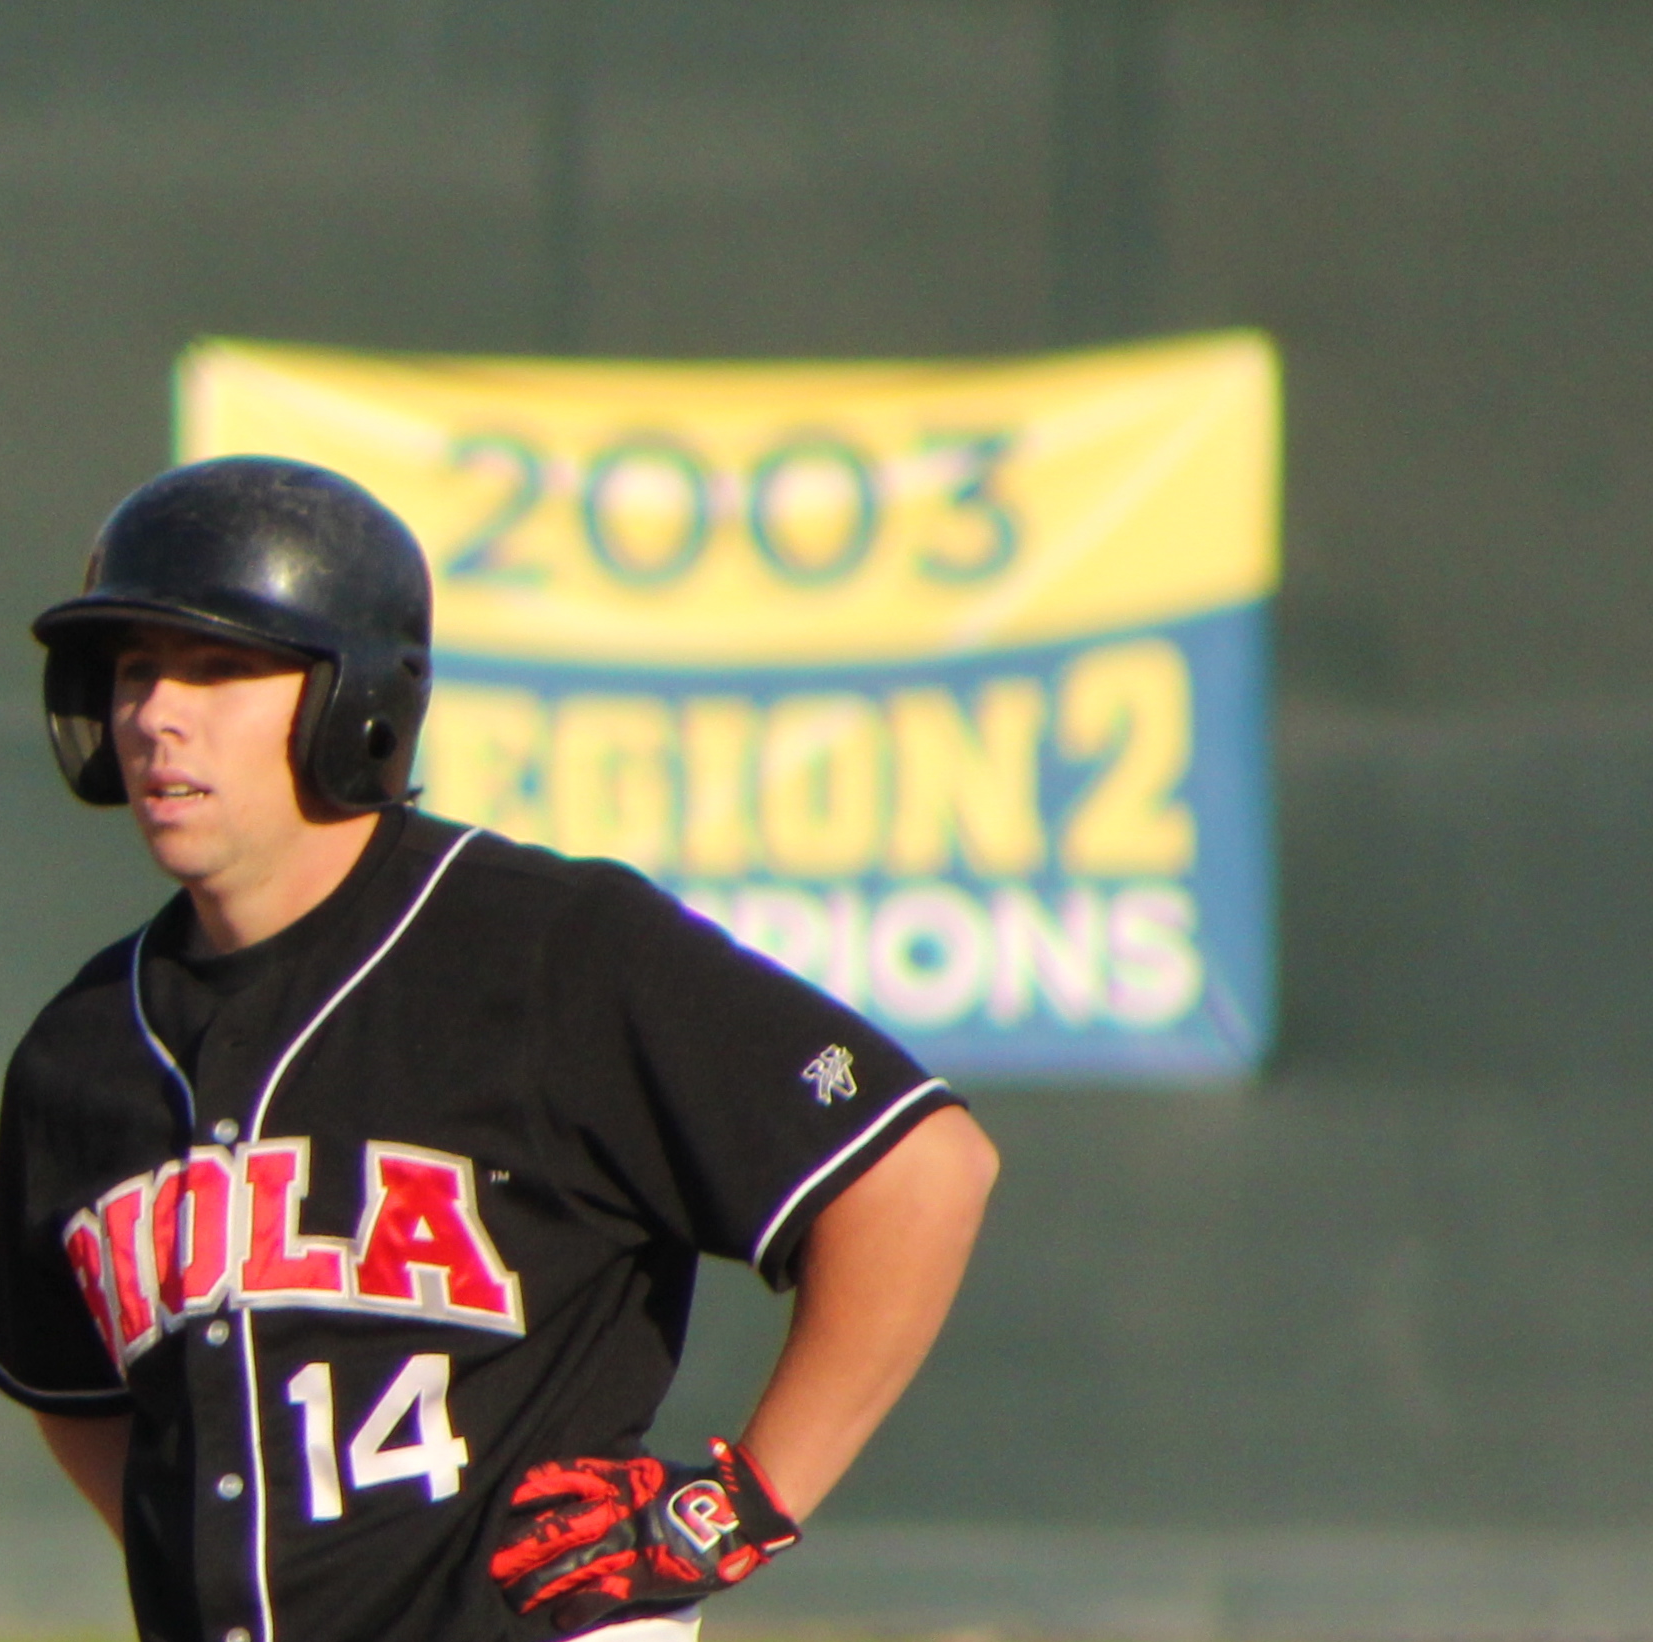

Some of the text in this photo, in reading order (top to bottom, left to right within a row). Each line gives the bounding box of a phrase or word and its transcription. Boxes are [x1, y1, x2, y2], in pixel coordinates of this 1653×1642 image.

[445, 436, 1023, 584] 2003
[428, 680, 1043, 876] EGION
[289, 1353, 469, 1521] 14
